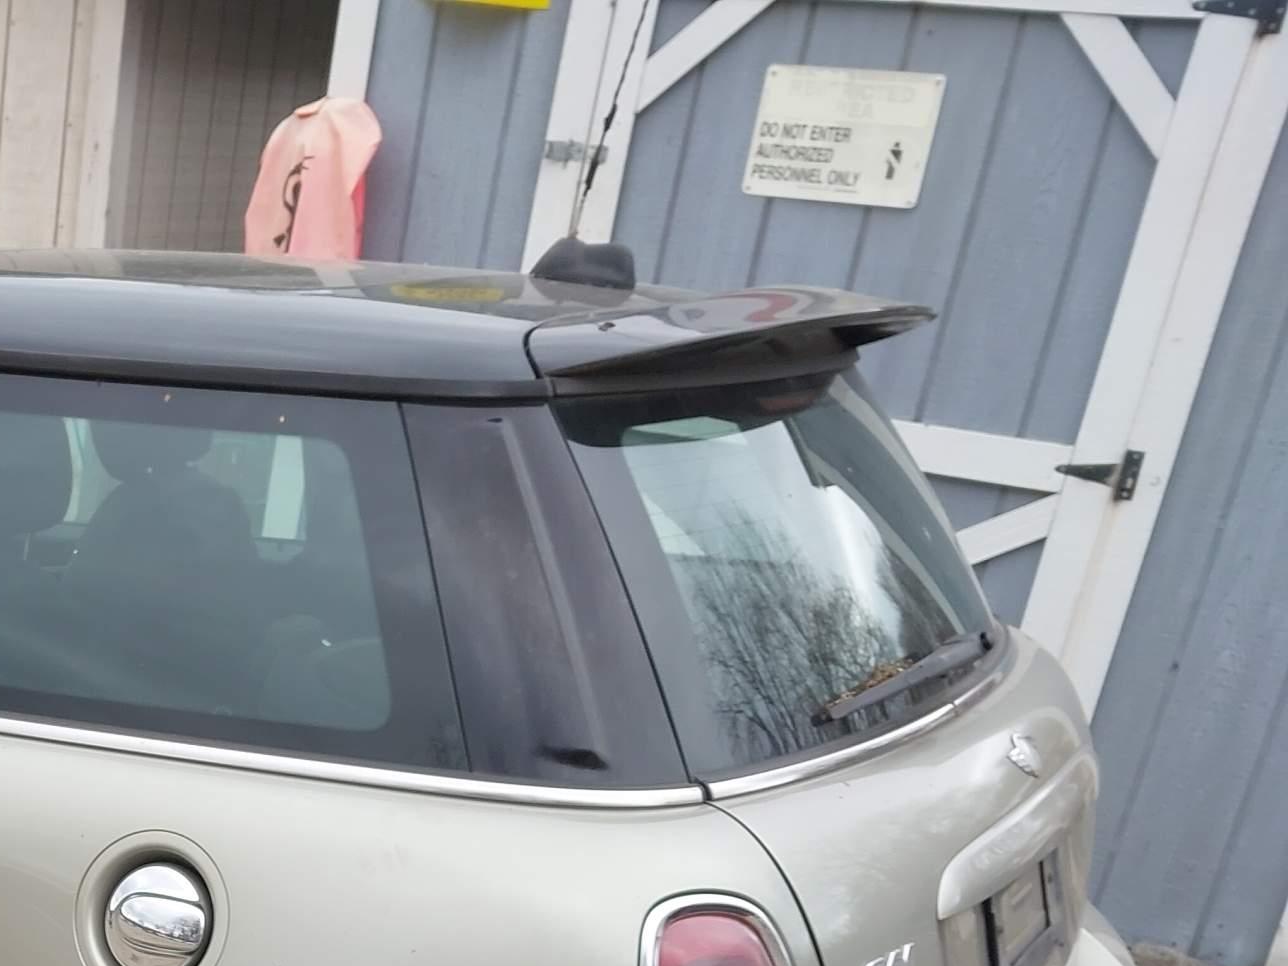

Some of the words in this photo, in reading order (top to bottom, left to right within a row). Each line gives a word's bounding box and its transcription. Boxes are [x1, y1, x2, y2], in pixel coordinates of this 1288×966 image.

[759, 121, 780, 138] DO
[781, 122, 807, 140] NOT
[809, 125, 853, 143] ENTER
[754, 142, 834, 163] AUTHORIZED
[751, 163, 823, 184] PERSONNEL
[826, 168, 861, 187] ONLY
